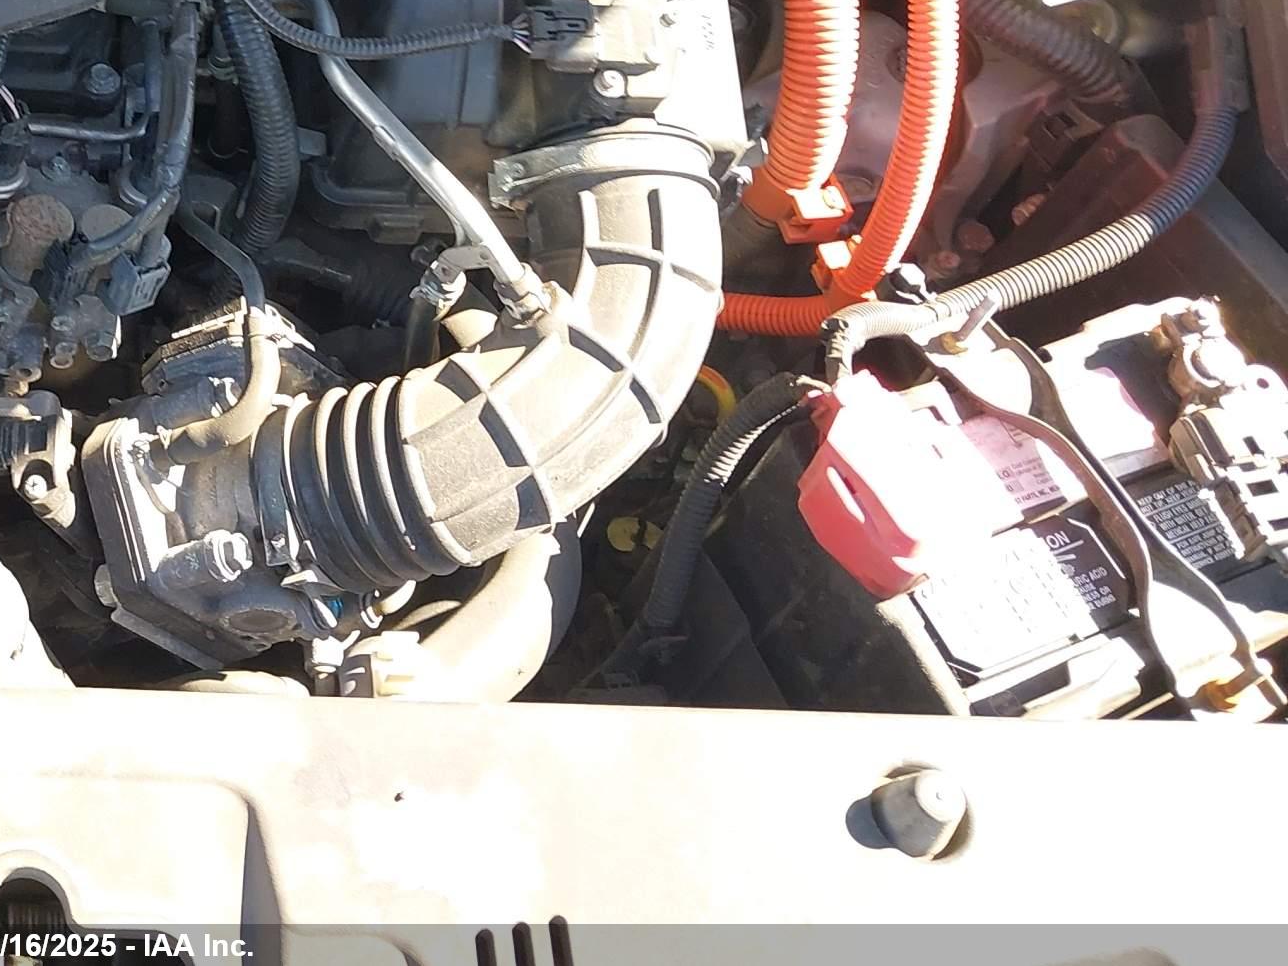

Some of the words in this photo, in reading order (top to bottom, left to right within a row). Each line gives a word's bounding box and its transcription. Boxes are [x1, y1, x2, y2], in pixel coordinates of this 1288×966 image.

[1136, 495, 1152, 505] KEEP
[1152, 491, 1165, 499] OUT
[1140, 504, 1153, 513] NOT
[1153, 510, 1173, 522] FLUSH
[1159, 519, 1176, 530] WITH
[1165, 524, 1190, 538] MEDICAL
[1189, 518, 1205, 528] HELP
[1087, 566, 1108, 579] ACID
